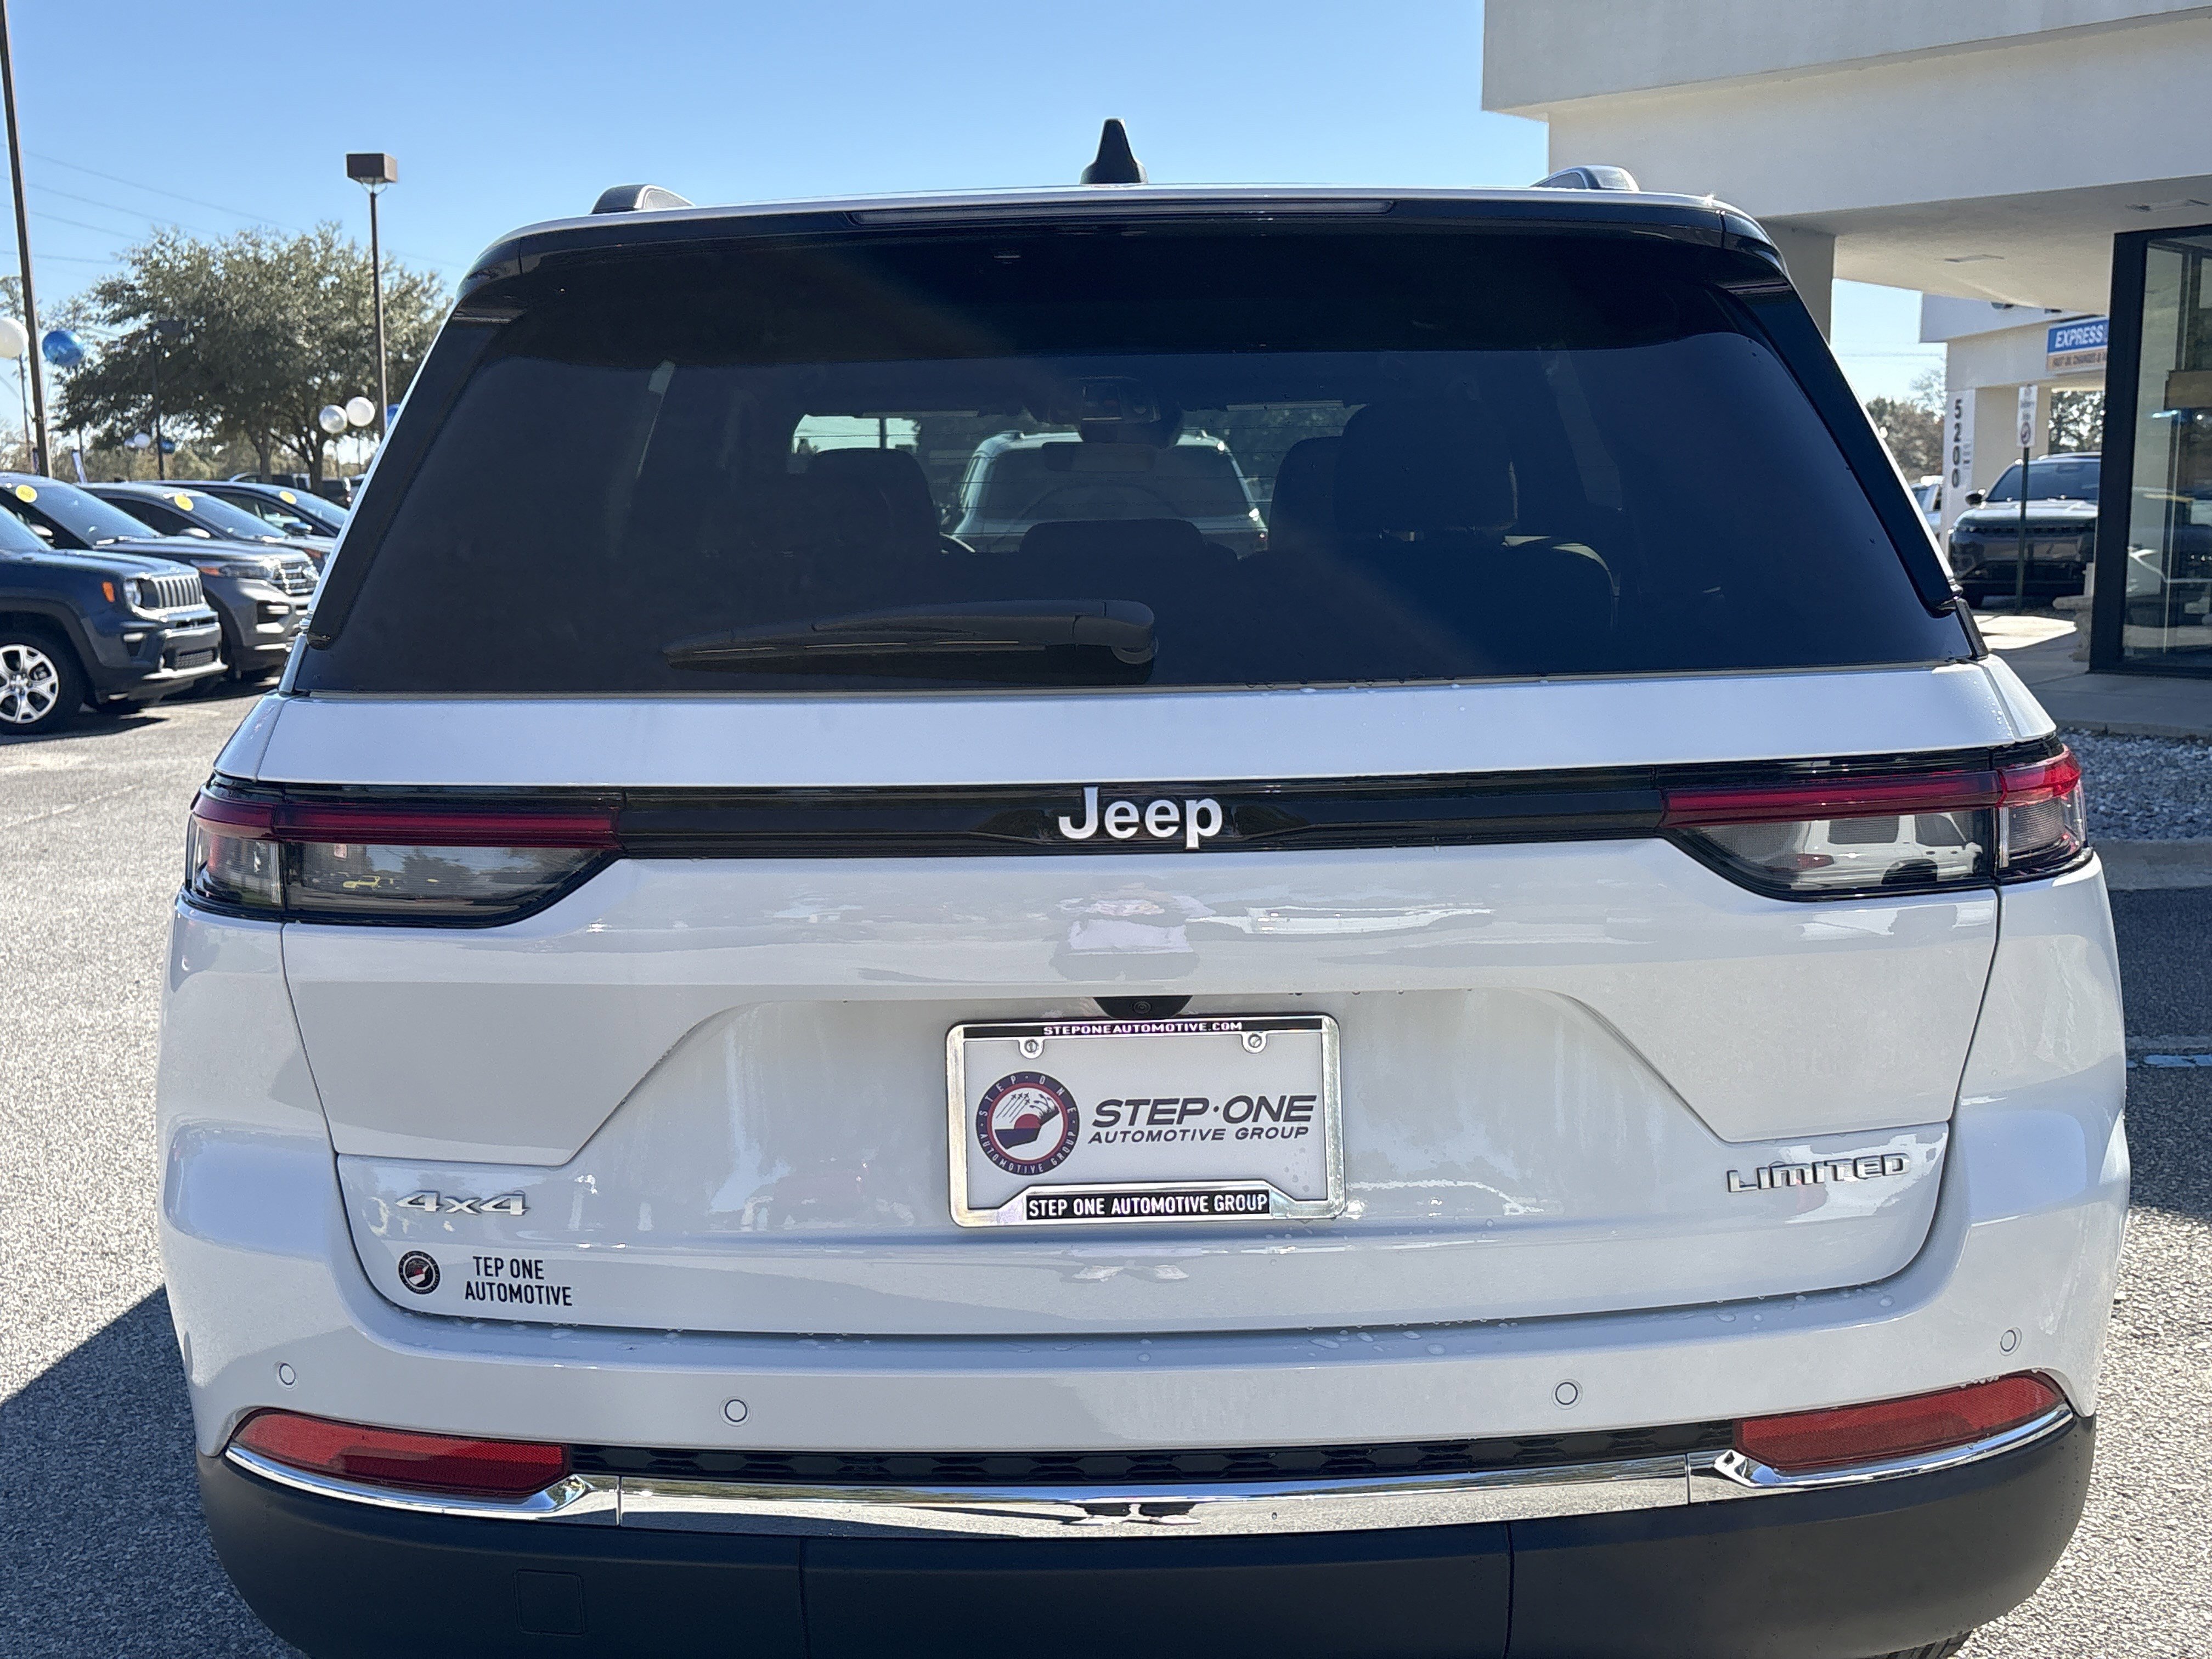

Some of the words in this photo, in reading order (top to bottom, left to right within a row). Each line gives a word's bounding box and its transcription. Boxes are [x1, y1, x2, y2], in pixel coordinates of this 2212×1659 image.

[2055, 325, 2103, 348] EXPRESS
[1951, 399, 1962, 488] 5200
[1058, 786, 1222, 849] Jeep
[1043, 1022, 1242, 1036] STEPONEAUTOMOTIVE.COM
[979, 1075, 1016, 1116] STEP
[1039, 1075, 1076, 1114] ONE
[1088, 1128, 1226, 1144] AUTOMOTIVE
[1235, 1126, 1309, 1141] GROUP
[980, 1133, 1043, 1173] AUTOMOTIVE
[1051, 1131, 1076, 1166] GROUP
[395, 1190, 528, 1216] 4x4
[1029, 1199, 1068, 1217] STEP
[1073, 1198, 1105, 1215] ONE
[1111, 1195, 1209, 1215] AUTOMOTIVE
[1214, 1194, 1267, 1212] GROUP
[472, 1255, 504, 1278] TEP
[510, 1258, 544, 1280] ONE
[465, 1281, 573, 1306] AUTOMOTIVE
